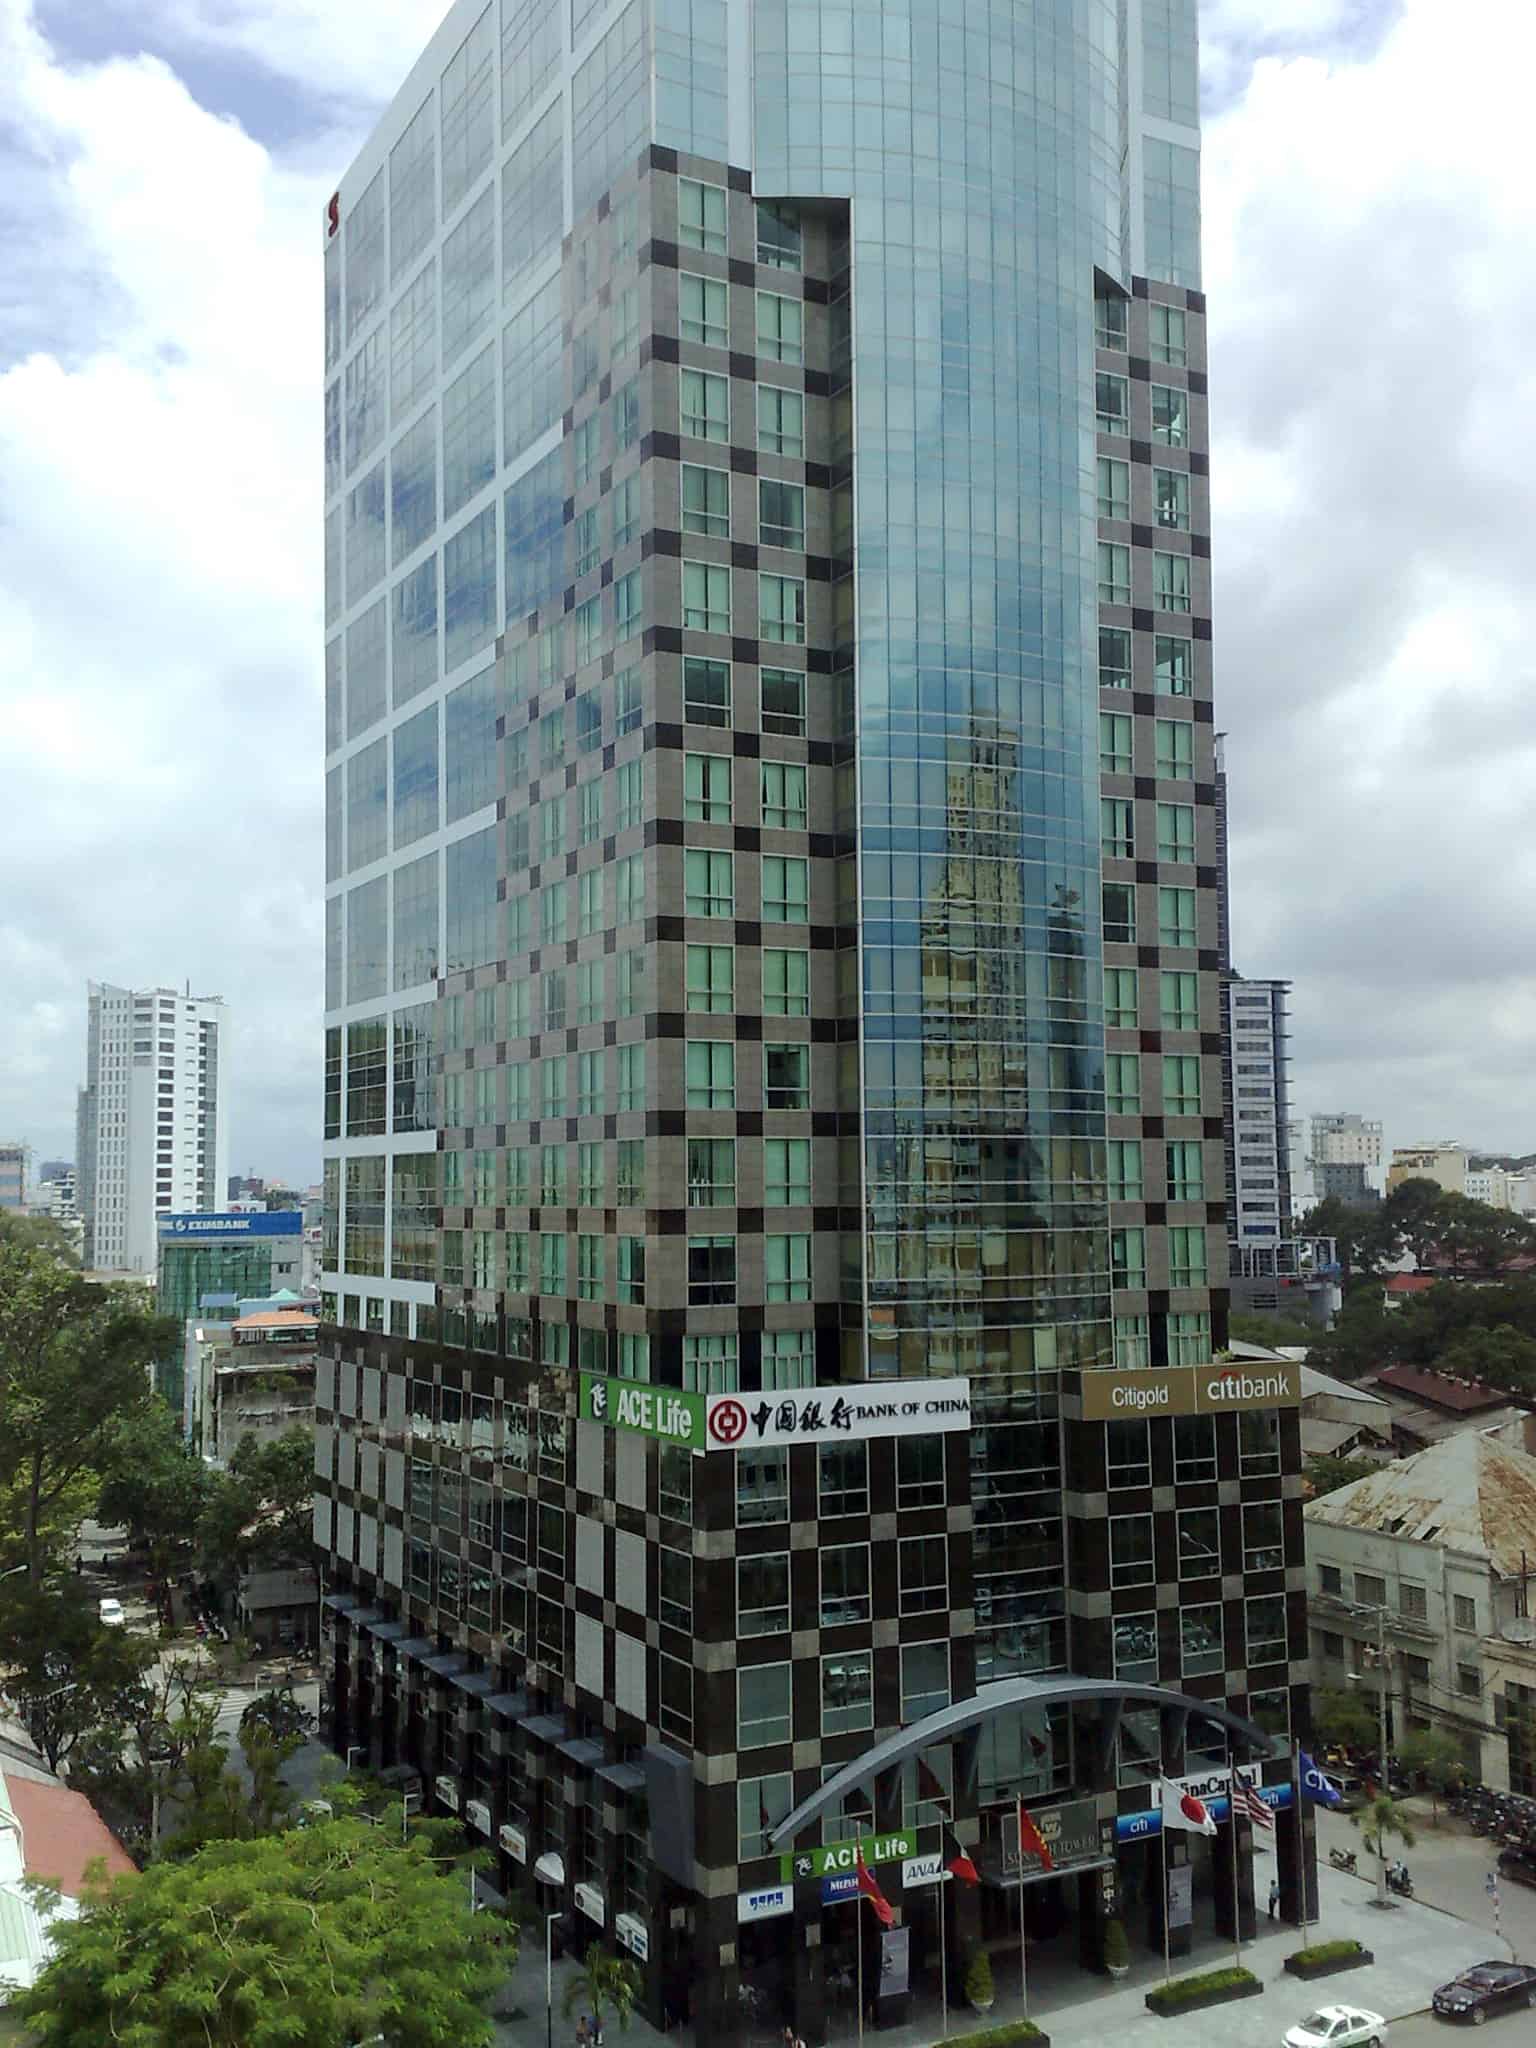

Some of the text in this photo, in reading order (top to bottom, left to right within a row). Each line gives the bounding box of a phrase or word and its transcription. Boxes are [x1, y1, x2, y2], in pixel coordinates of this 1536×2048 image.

[1111, 1372, 1290, 1410] Citigold citibank
[617, 1388, 693, 1438] ACE Life
[857, 1399, 970, 1420] BANK OF CHINA
[1130, 1818, 1149, 1834] citi
[874, 1837, 908, 1860] Life
